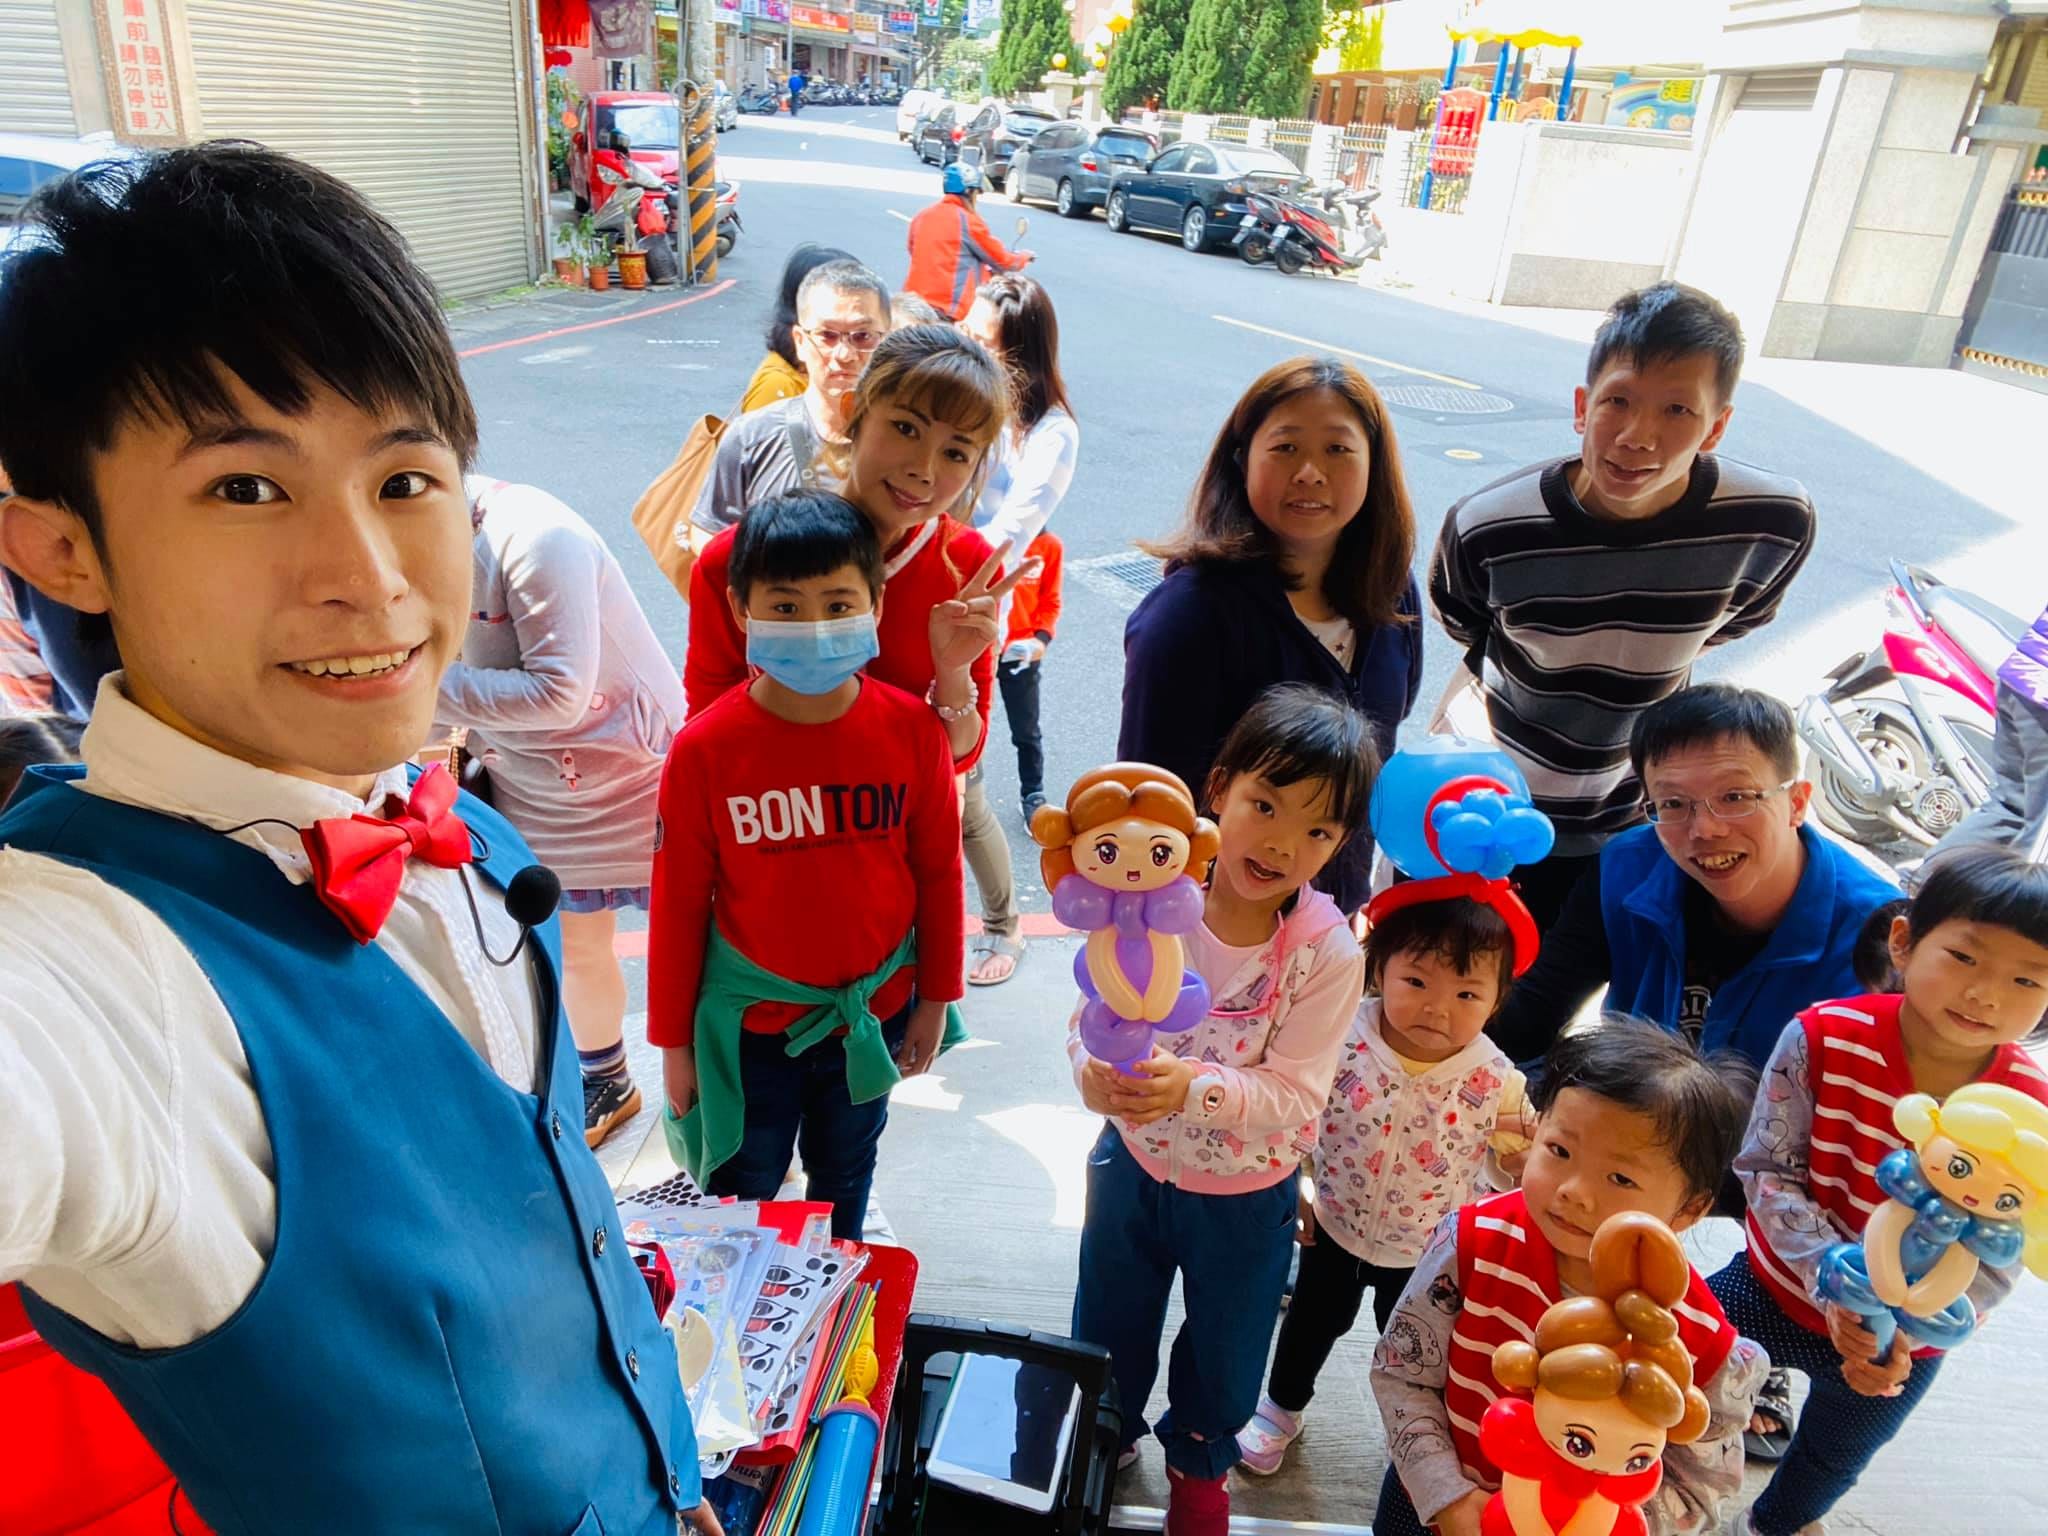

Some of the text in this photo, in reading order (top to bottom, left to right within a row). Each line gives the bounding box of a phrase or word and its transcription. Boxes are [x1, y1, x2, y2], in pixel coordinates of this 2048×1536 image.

[119, 43, 148, 129] 請勿停車
[143, 45, 172, 130] 隨時出入
[726, 783, 907, 845] BONTON
